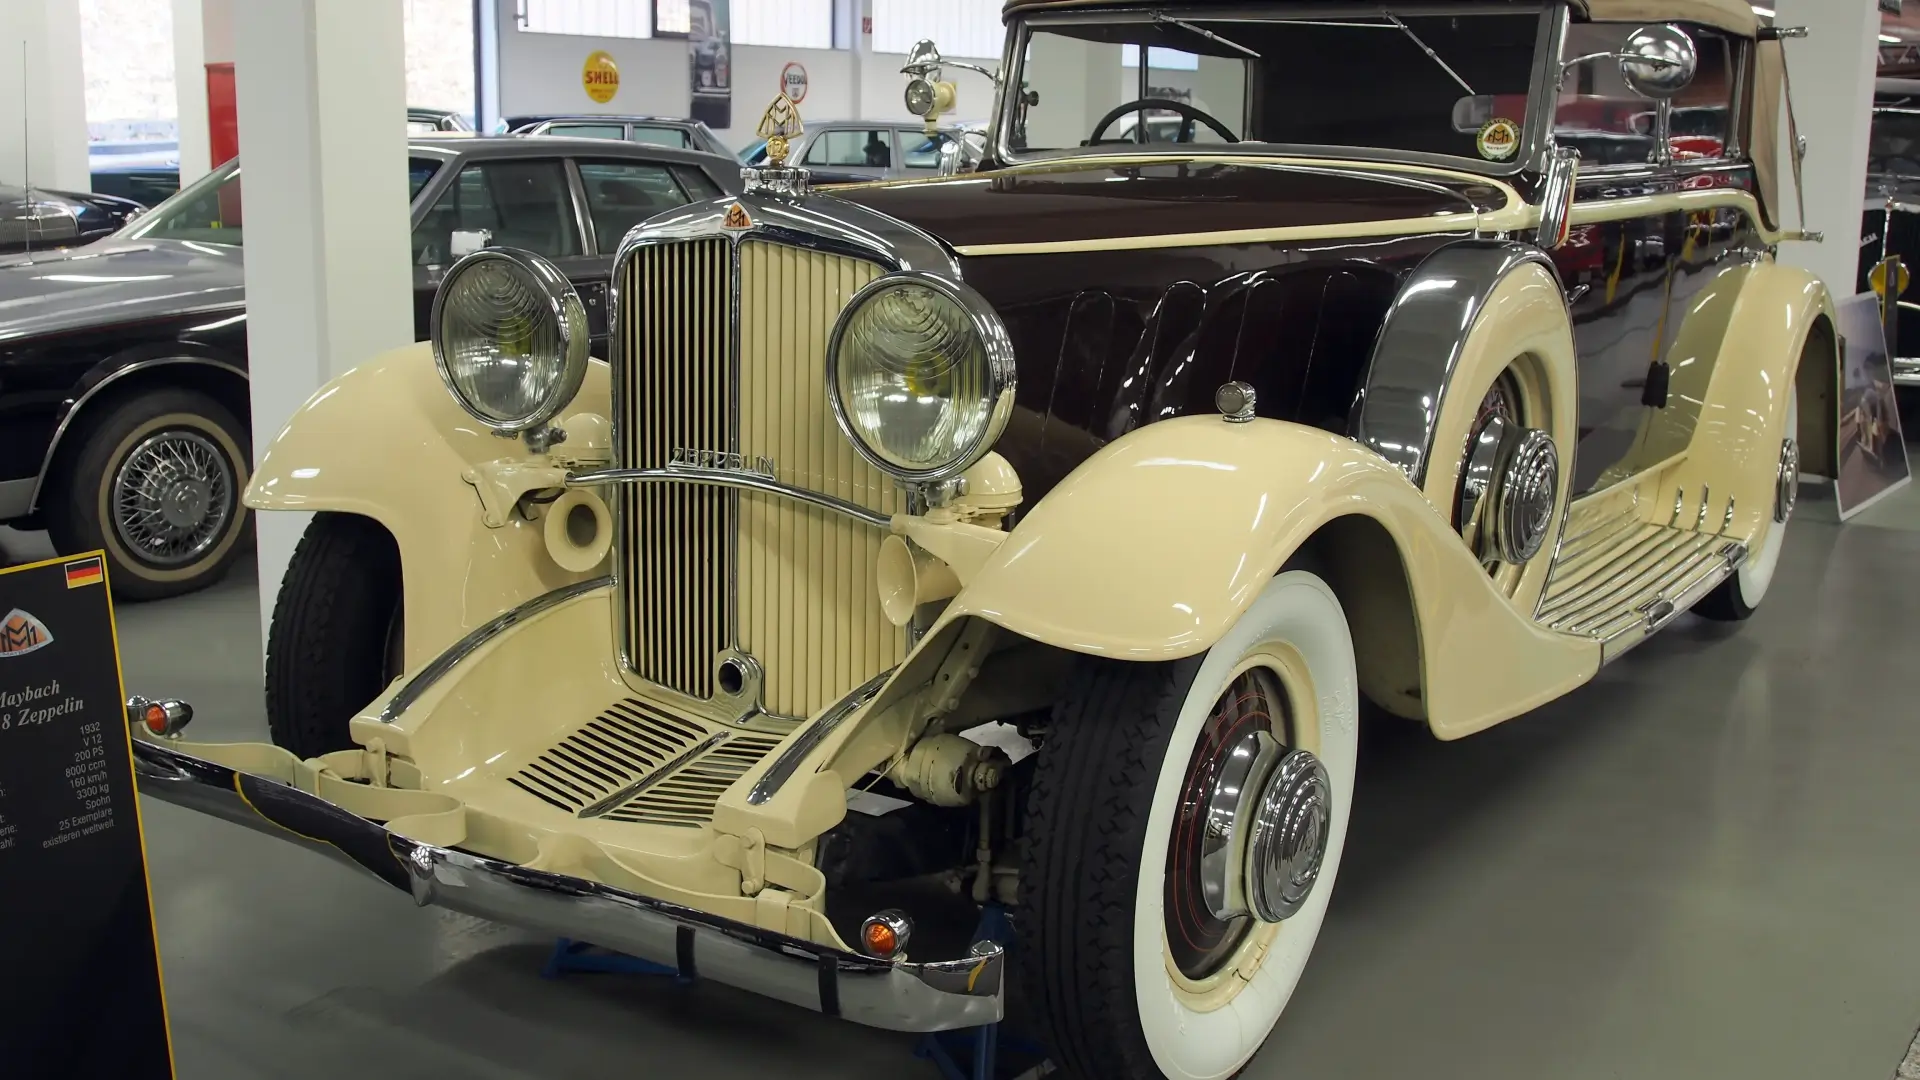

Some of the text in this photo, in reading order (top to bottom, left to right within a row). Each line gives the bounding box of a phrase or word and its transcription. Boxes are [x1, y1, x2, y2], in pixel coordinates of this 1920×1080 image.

[585, 71, 618, 84] SHELL
[668, 447, 774, 476] ZEPPELIN
[2, 697, 84, 730] 8 Zeppelin
[80, 721, 101, 735] 1932
[83, 733, 103, 747] V 12
[74, 745, 104, 762] 200 PS
[65, 759, 106, 778] 8000 ccm
[70, 770, 108, 789] 160 km/h
[76, 783, 110, 800] 3300 kg
[85, 795, 111, 810] Spohn
[59, 807, 113, 831] 25 Exemplare
[42, 818, 115, 849] existieren weltweit
